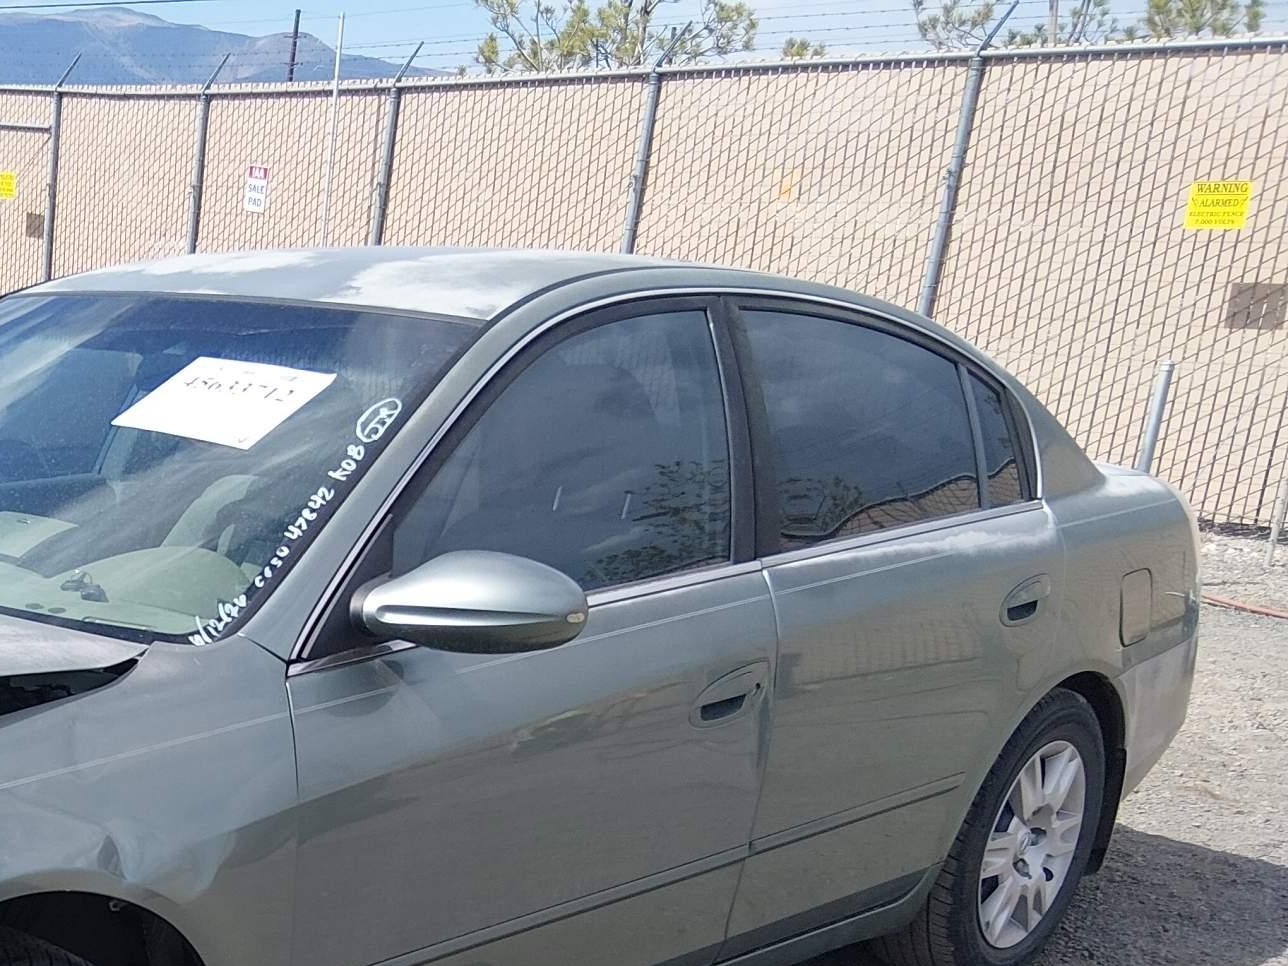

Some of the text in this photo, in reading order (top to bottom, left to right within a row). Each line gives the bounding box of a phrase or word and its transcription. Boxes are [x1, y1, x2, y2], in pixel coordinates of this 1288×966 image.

[248, 184, 265, 194] SALE
[1197, 183, 1249, 193] WARNING
[248, 197, 262, 207] PAD
[1199, 199, 1240, 207] ALARMED
